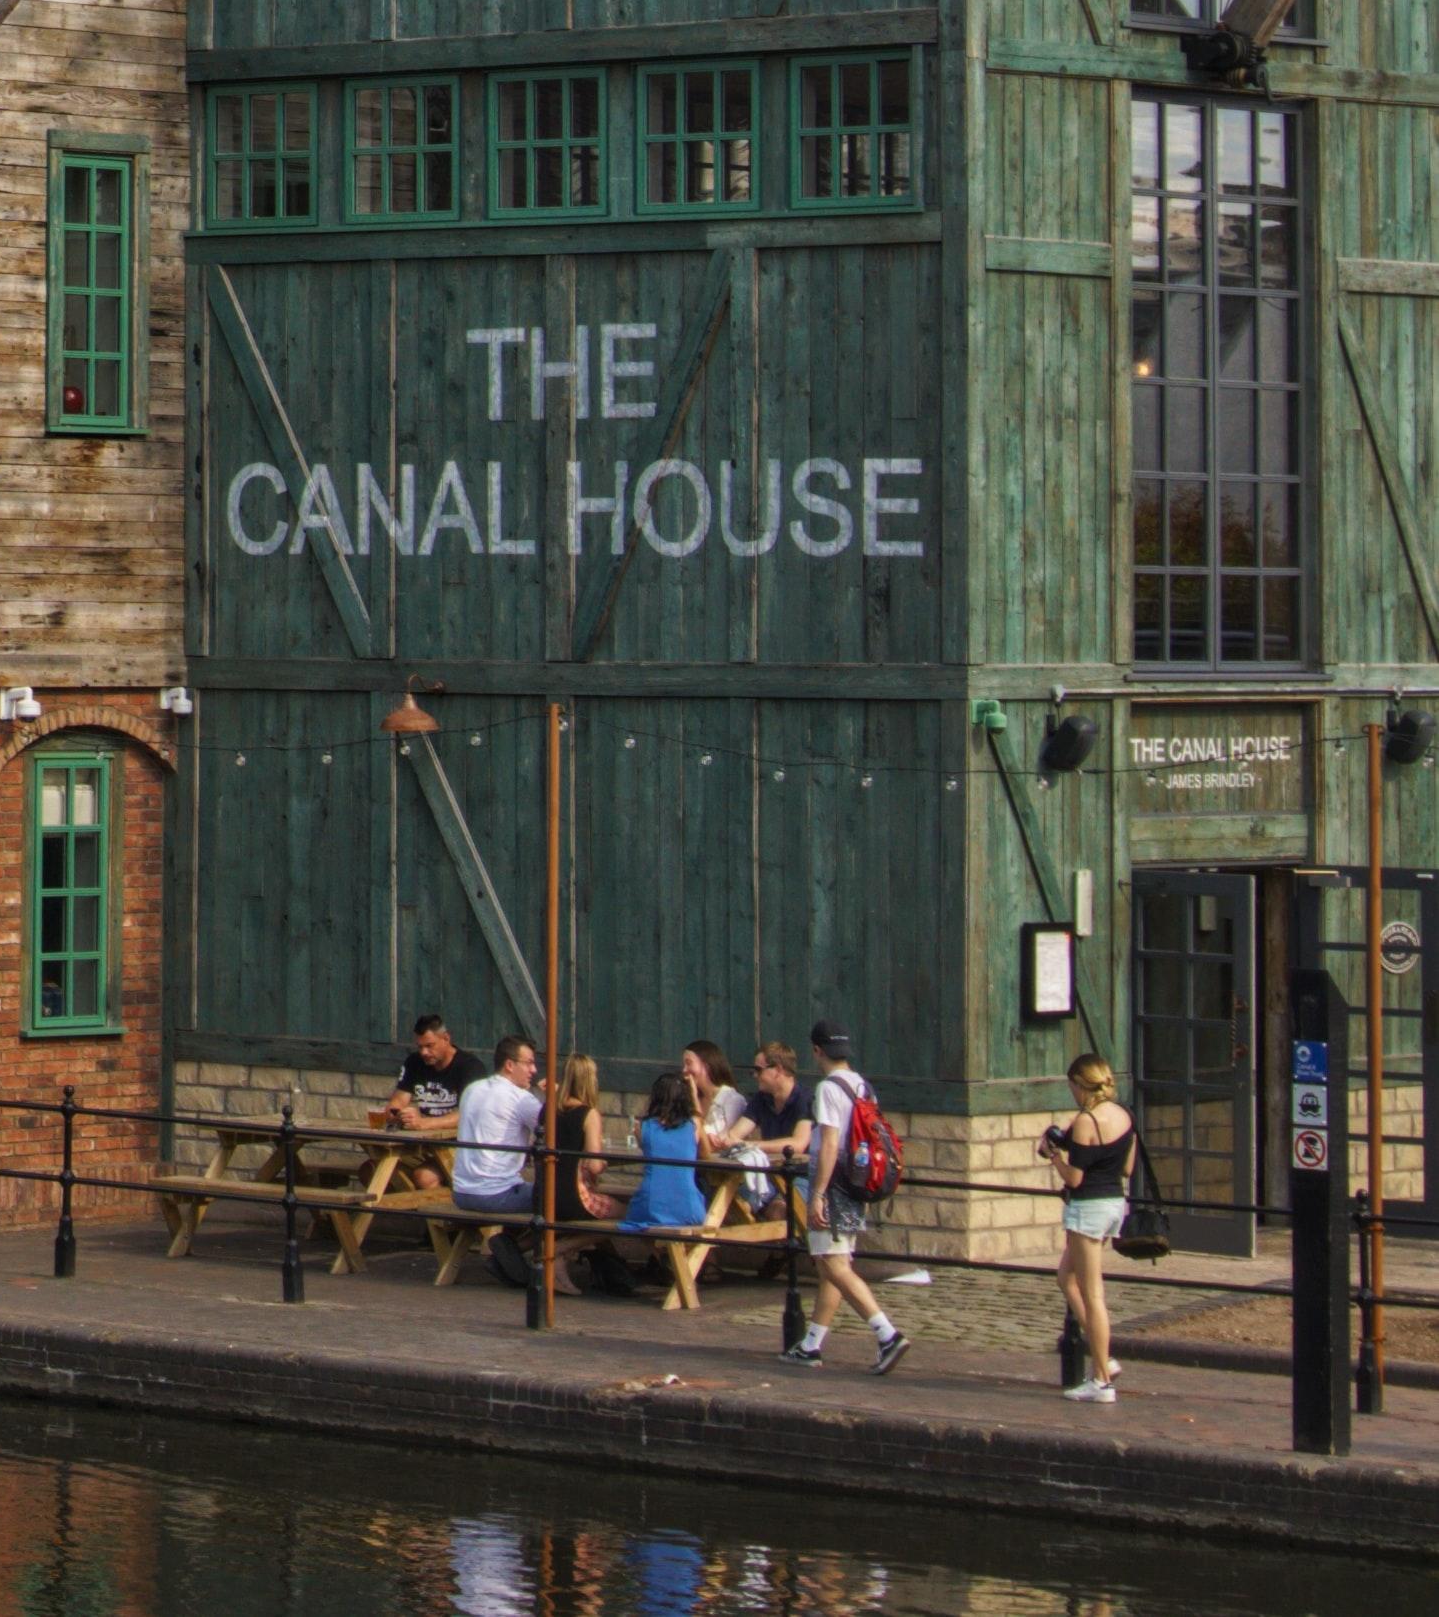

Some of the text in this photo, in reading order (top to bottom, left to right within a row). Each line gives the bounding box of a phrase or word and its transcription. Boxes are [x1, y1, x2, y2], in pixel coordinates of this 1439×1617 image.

[466, 323, 657, 421] THE
[226, 457, 923, 557] CANAL HOUSE
[1130, 736, 1291, 762] THE CANAL HOUSE
[1166, 772, 1255, 789] JAMES BRINDLEY
